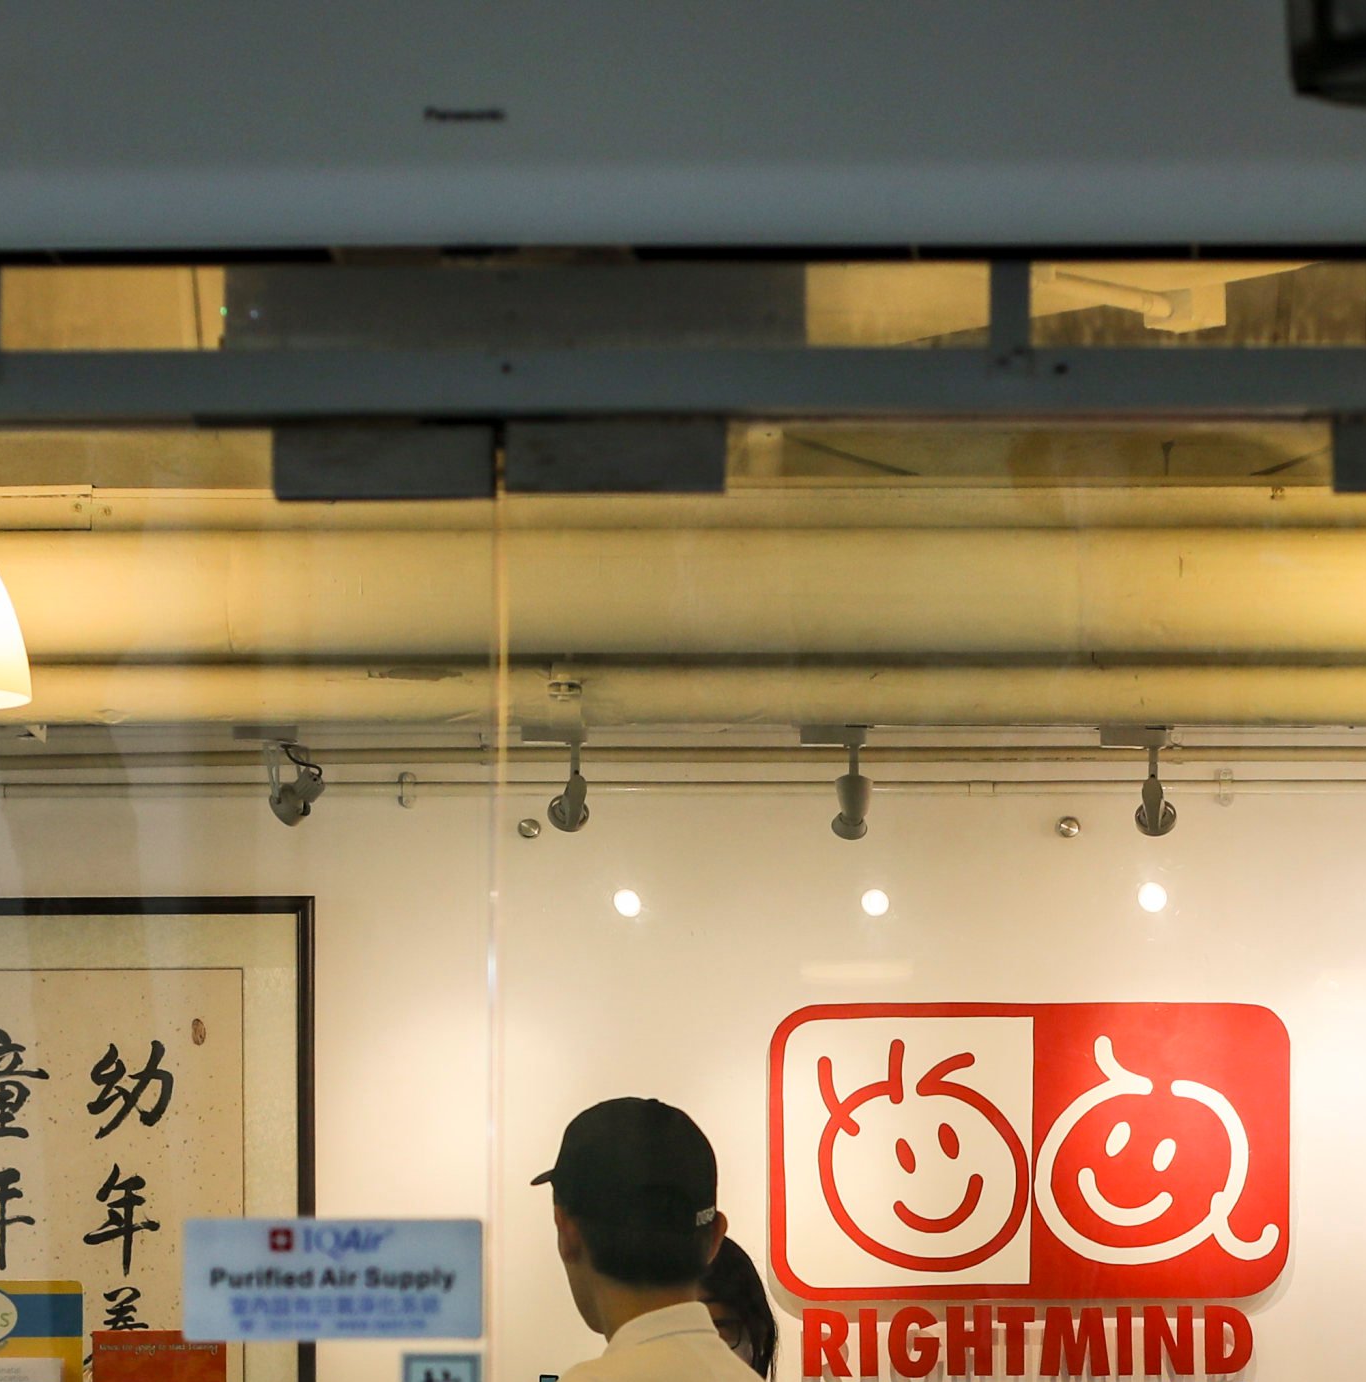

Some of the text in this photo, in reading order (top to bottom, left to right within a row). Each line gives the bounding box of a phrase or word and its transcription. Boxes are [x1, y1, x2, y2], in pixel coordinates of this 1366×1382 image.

[209, 1266, 456, 1292] Purified Air Supply
[801, 1305, 1254, 1378] RIGHTMIND
